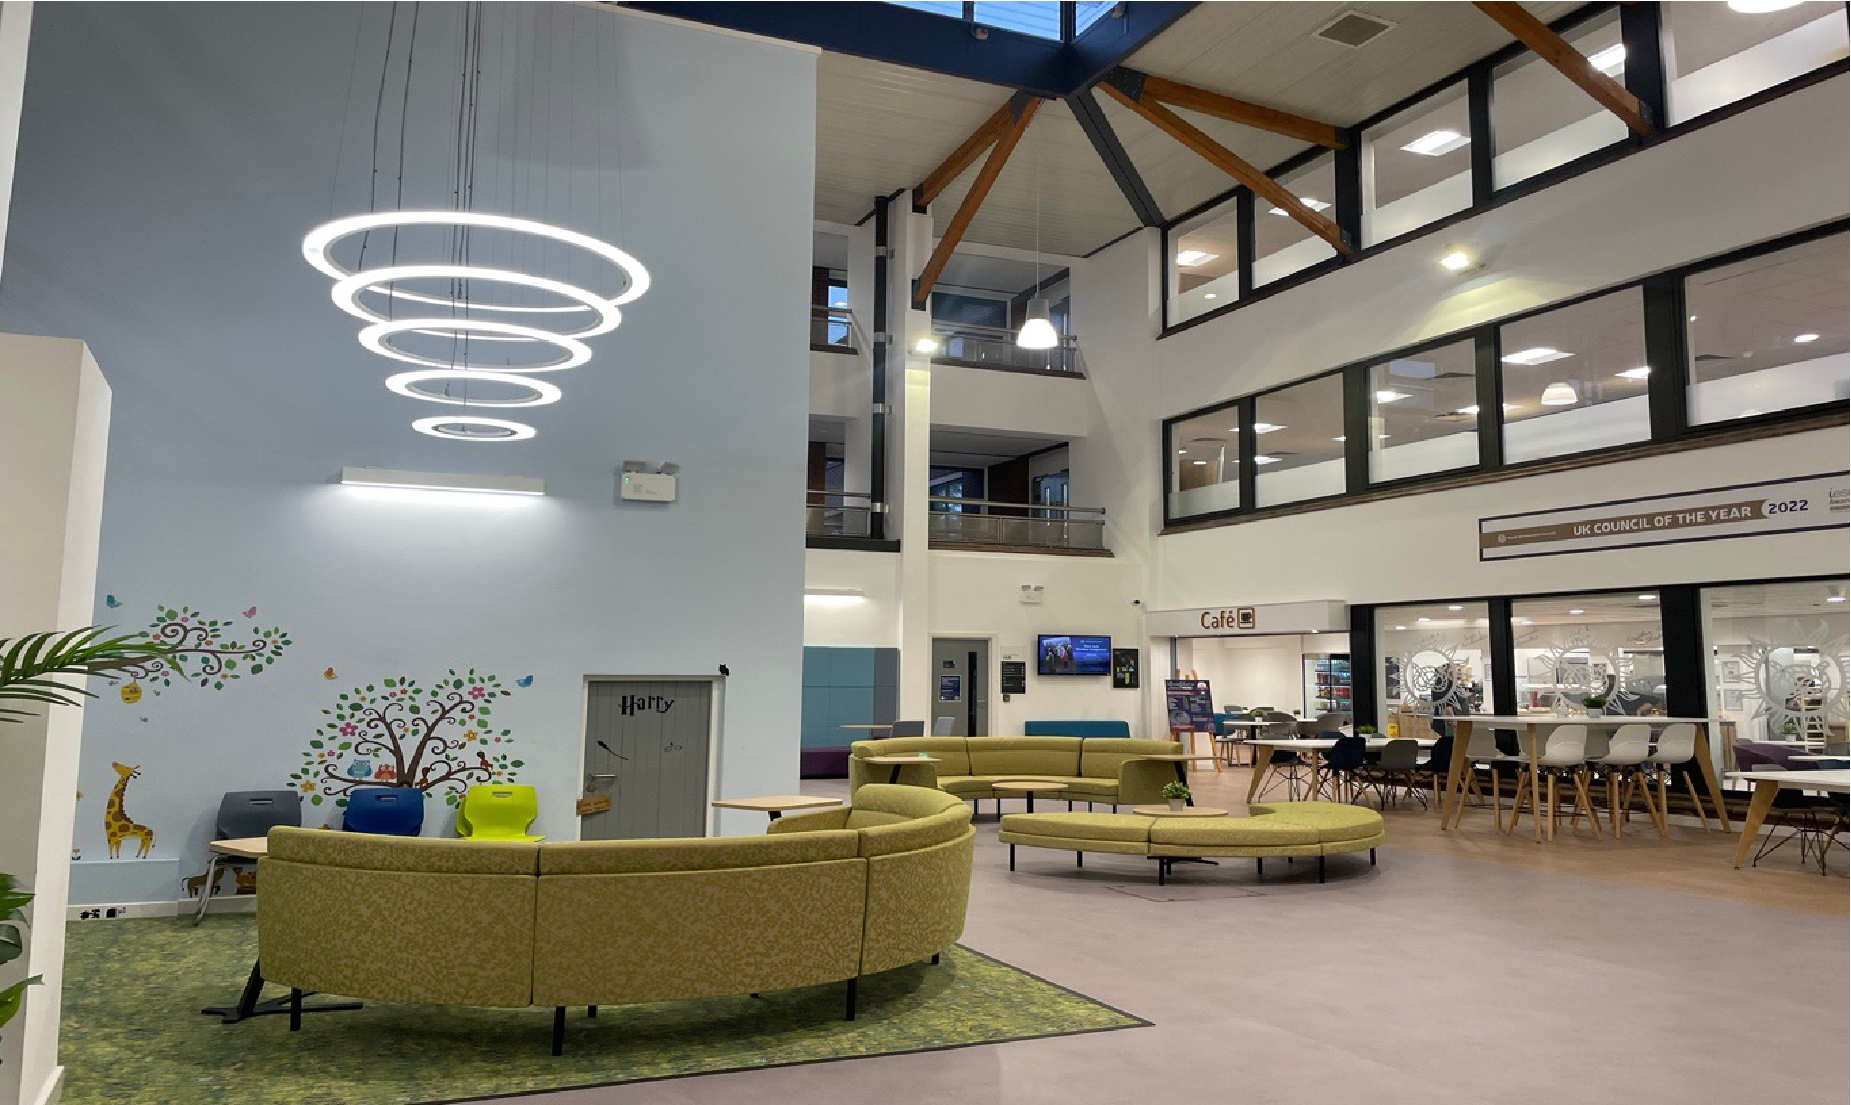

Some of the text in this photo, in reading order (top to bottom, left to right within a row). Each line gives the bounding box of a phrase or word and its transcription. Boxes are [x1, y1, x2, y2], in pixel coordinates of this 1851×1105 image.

[1573, 524, 1591, 535] UK
[1594, 518, 1651, 533] COUNCIL
[1654, 514, 1673, 527] OF
[1677, 511, 1705, 524] THE
[1709, 506, 1752, 520] YEAR
[1768, 499, 1809, 515] 2022
[1200, 610, 1235, 629] Café
[618, 694, 675, 716] Harry
